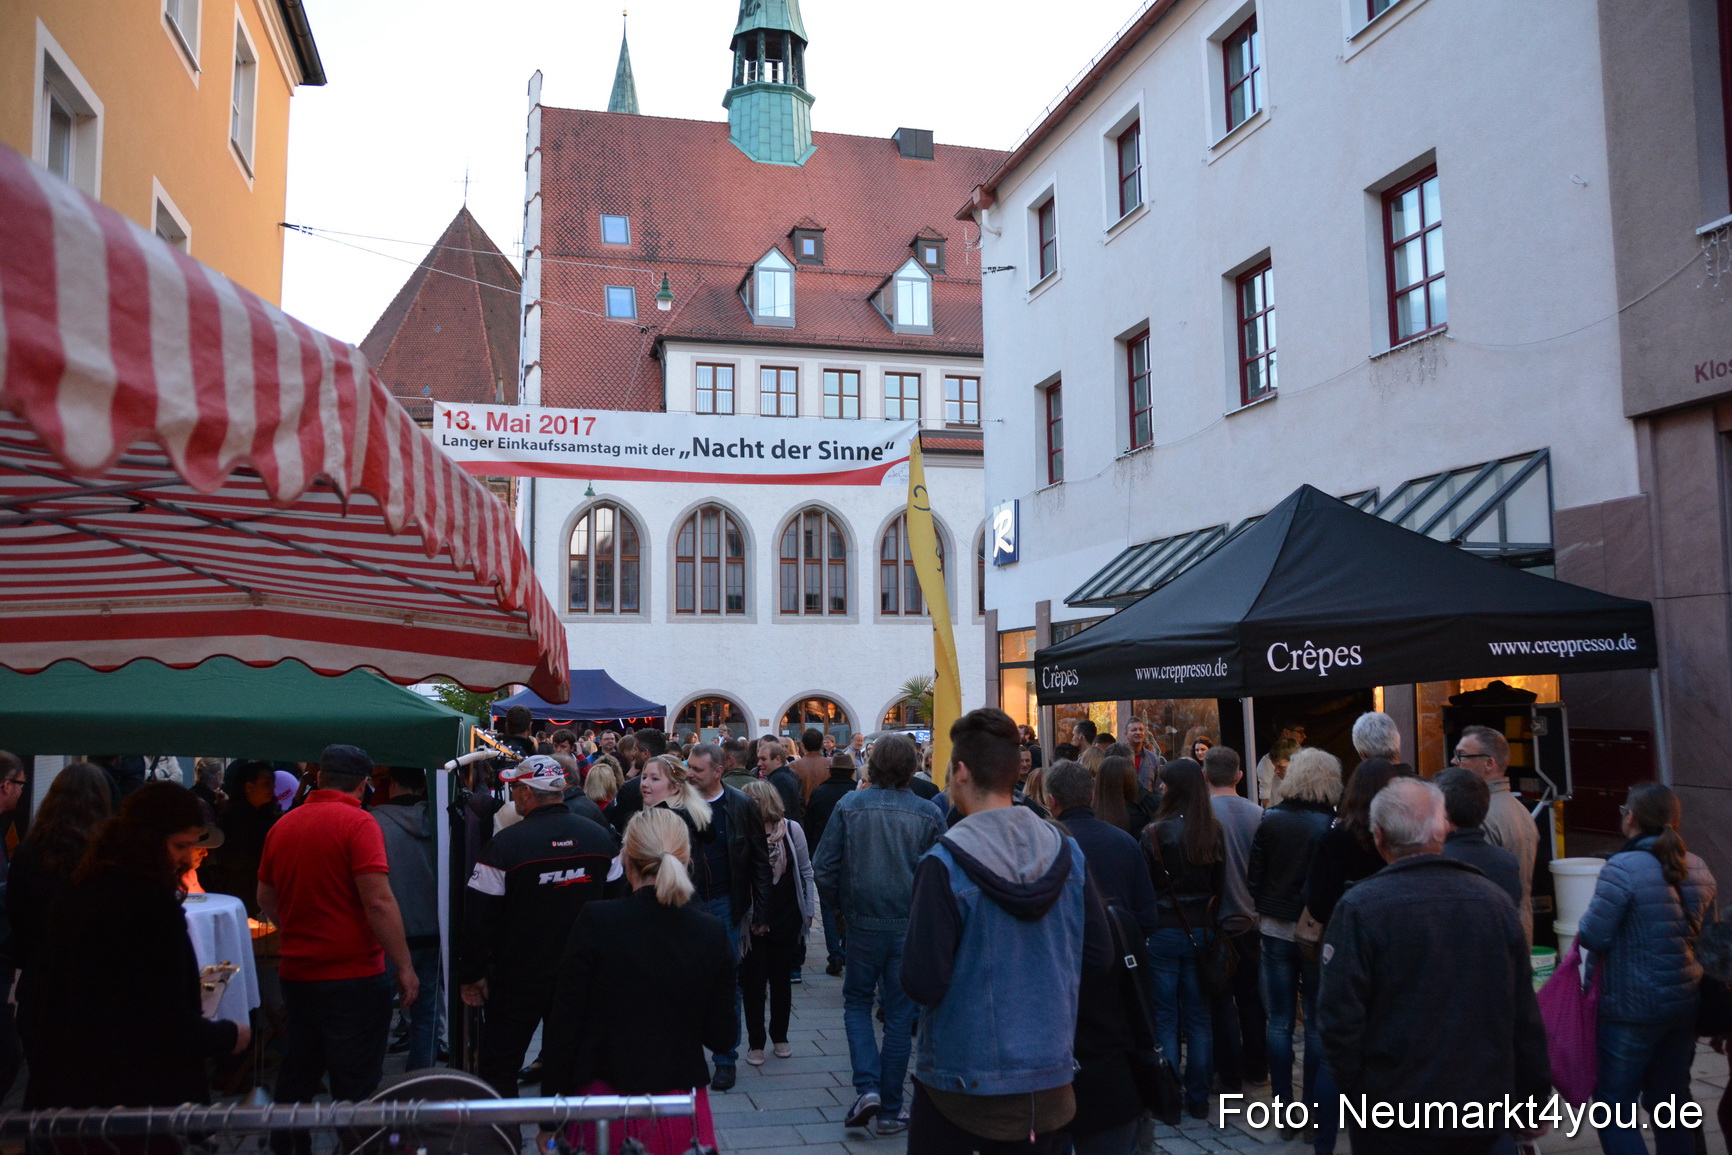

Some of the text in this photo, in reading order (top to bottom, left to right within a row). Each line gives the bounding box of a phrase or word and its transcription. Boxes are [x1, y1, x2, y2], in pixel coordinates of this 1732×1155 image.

[442, 409, 597, 436] 13. Mai 2017
[442, 434, 494, 451] Langer
[497, 437, 621, 457] Einkaufssamstag
[625, 443, 648, 455] mit
[651, 445, 675, 456] der
[771, 439, 812, 460] der
[993, 509, 1014, 558] R
[1266, 640, 1363, 677] Crêpes
[1489, 633, 1637, 657] www.creppresso.de
[1042, 665, 1079, 694] Crêpes
[1135, 657, 1228, 684] www.creppresso.de
[538, 867, 586, 885] FLM
